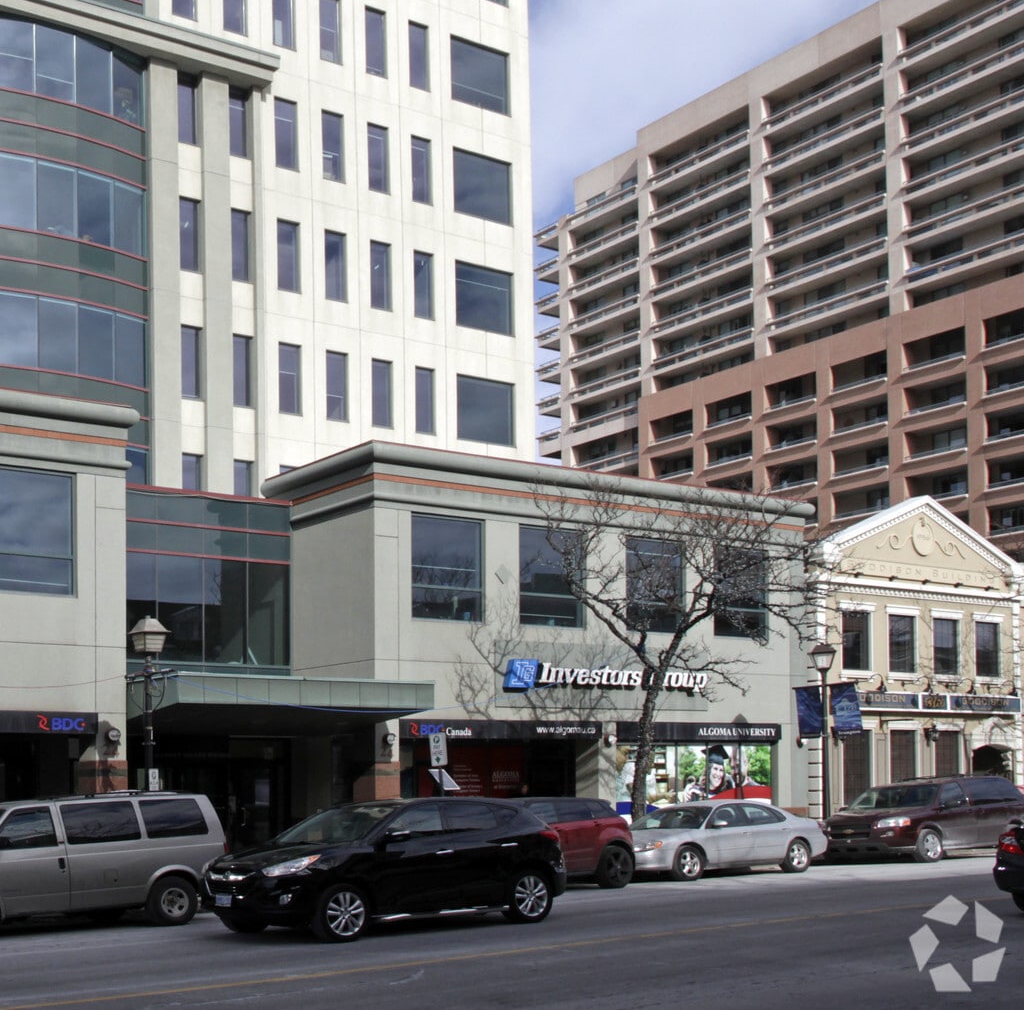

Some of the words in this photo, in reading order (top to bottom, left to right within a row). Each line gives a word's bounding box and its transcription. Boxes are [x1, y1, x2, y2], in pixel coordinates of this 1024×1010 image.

[539, 662, 642, 685] Investors
[51, 718, 85, 730] BDC
[445, 727, 472, 736] Canada
[536, 725, 596, 735] www.algomau.ca
[698, 727, 731, 736] ALGOMA
[733, 728, 776, 736] UNIVERSITY
